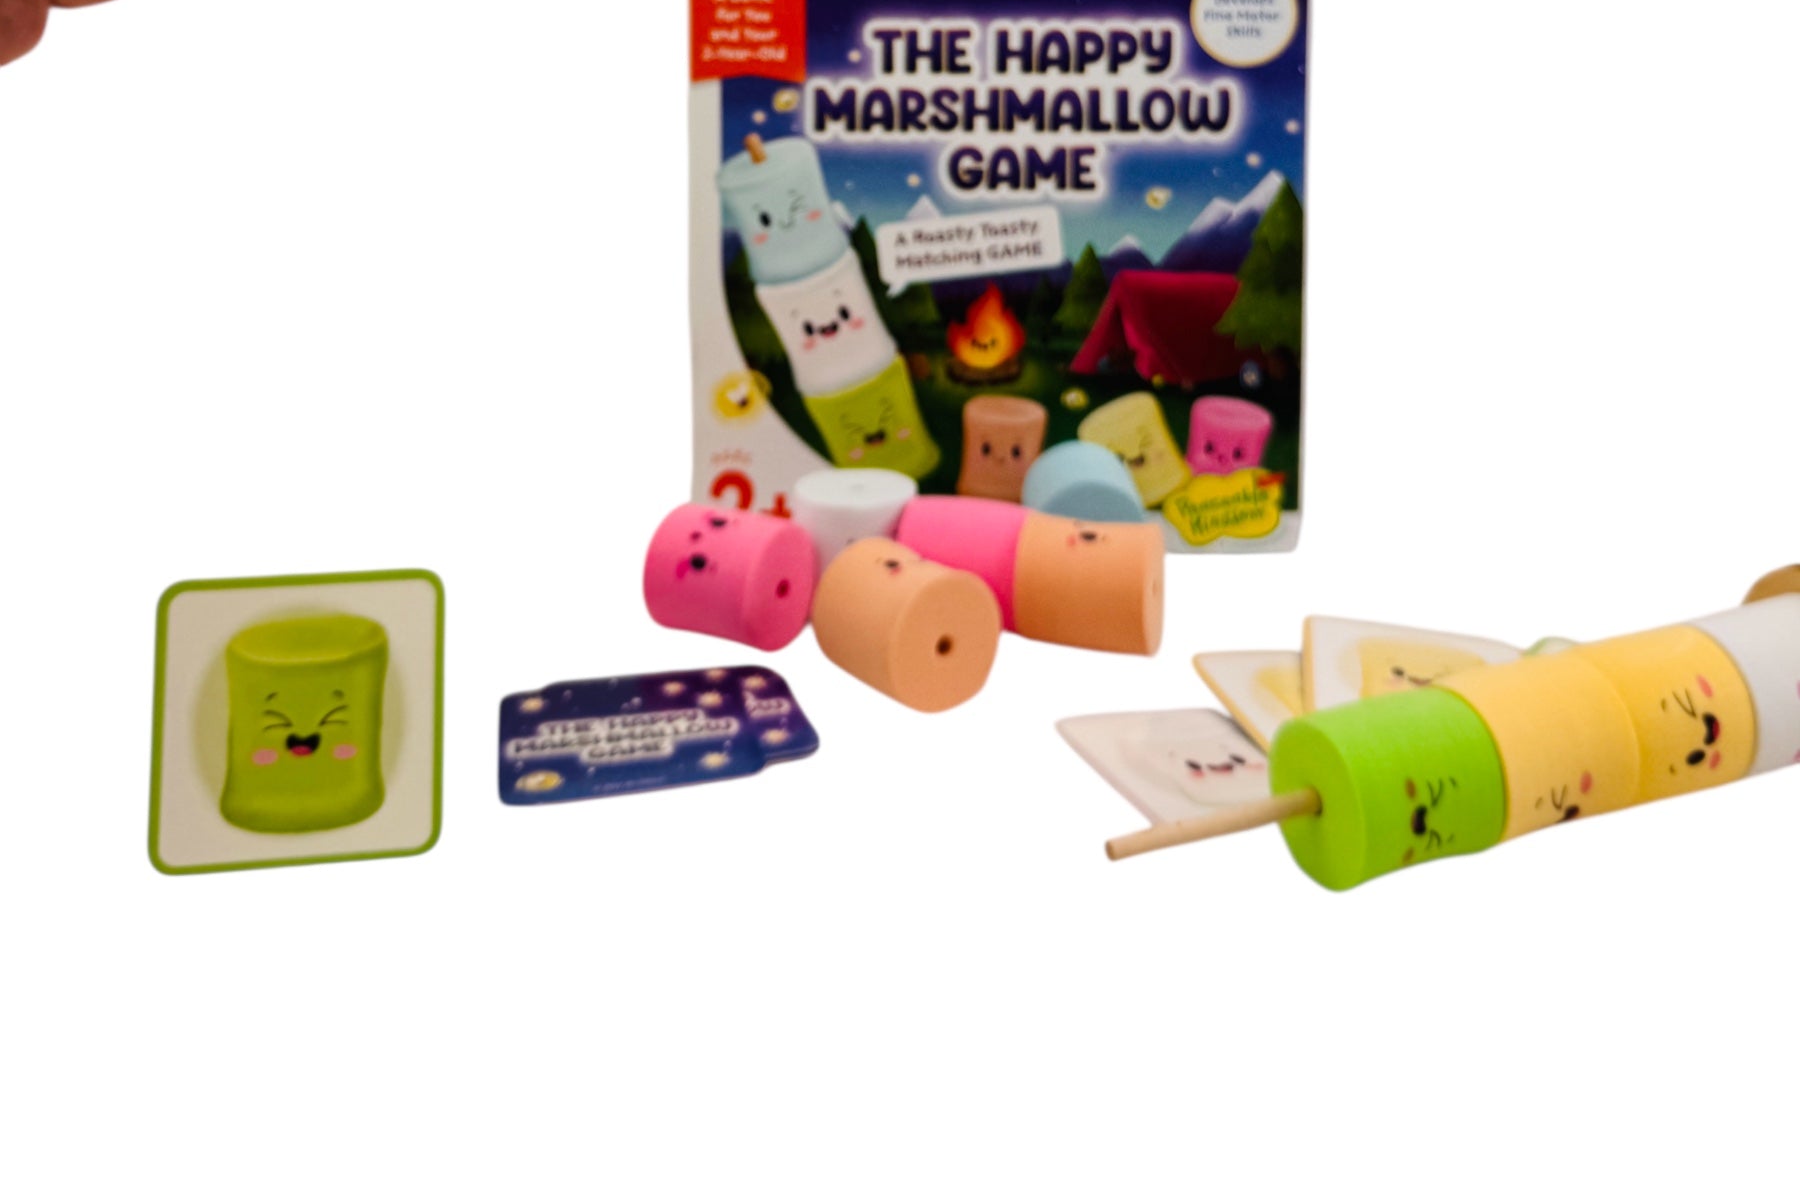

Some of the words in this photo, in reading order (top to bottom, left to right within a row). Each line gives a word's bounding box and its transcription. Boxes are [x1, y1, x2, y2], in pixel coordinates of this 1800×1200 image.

[873, 29, 971, 74] THE
[999, 29, 1173, 74] HAPPY
[813, 87, 1231, 133] MARSHMALLOW
[948, 146, 1097, 191] GAME
[895, 232, 907, 246] A
[912, 225, 974, 244] Roasty
[978, 218, 1039, 238] Toasty
[895, 249, 982, 268] Matching
[986, 241, 1043, 260] GAME
[584, 744, 668, 760] GAME
